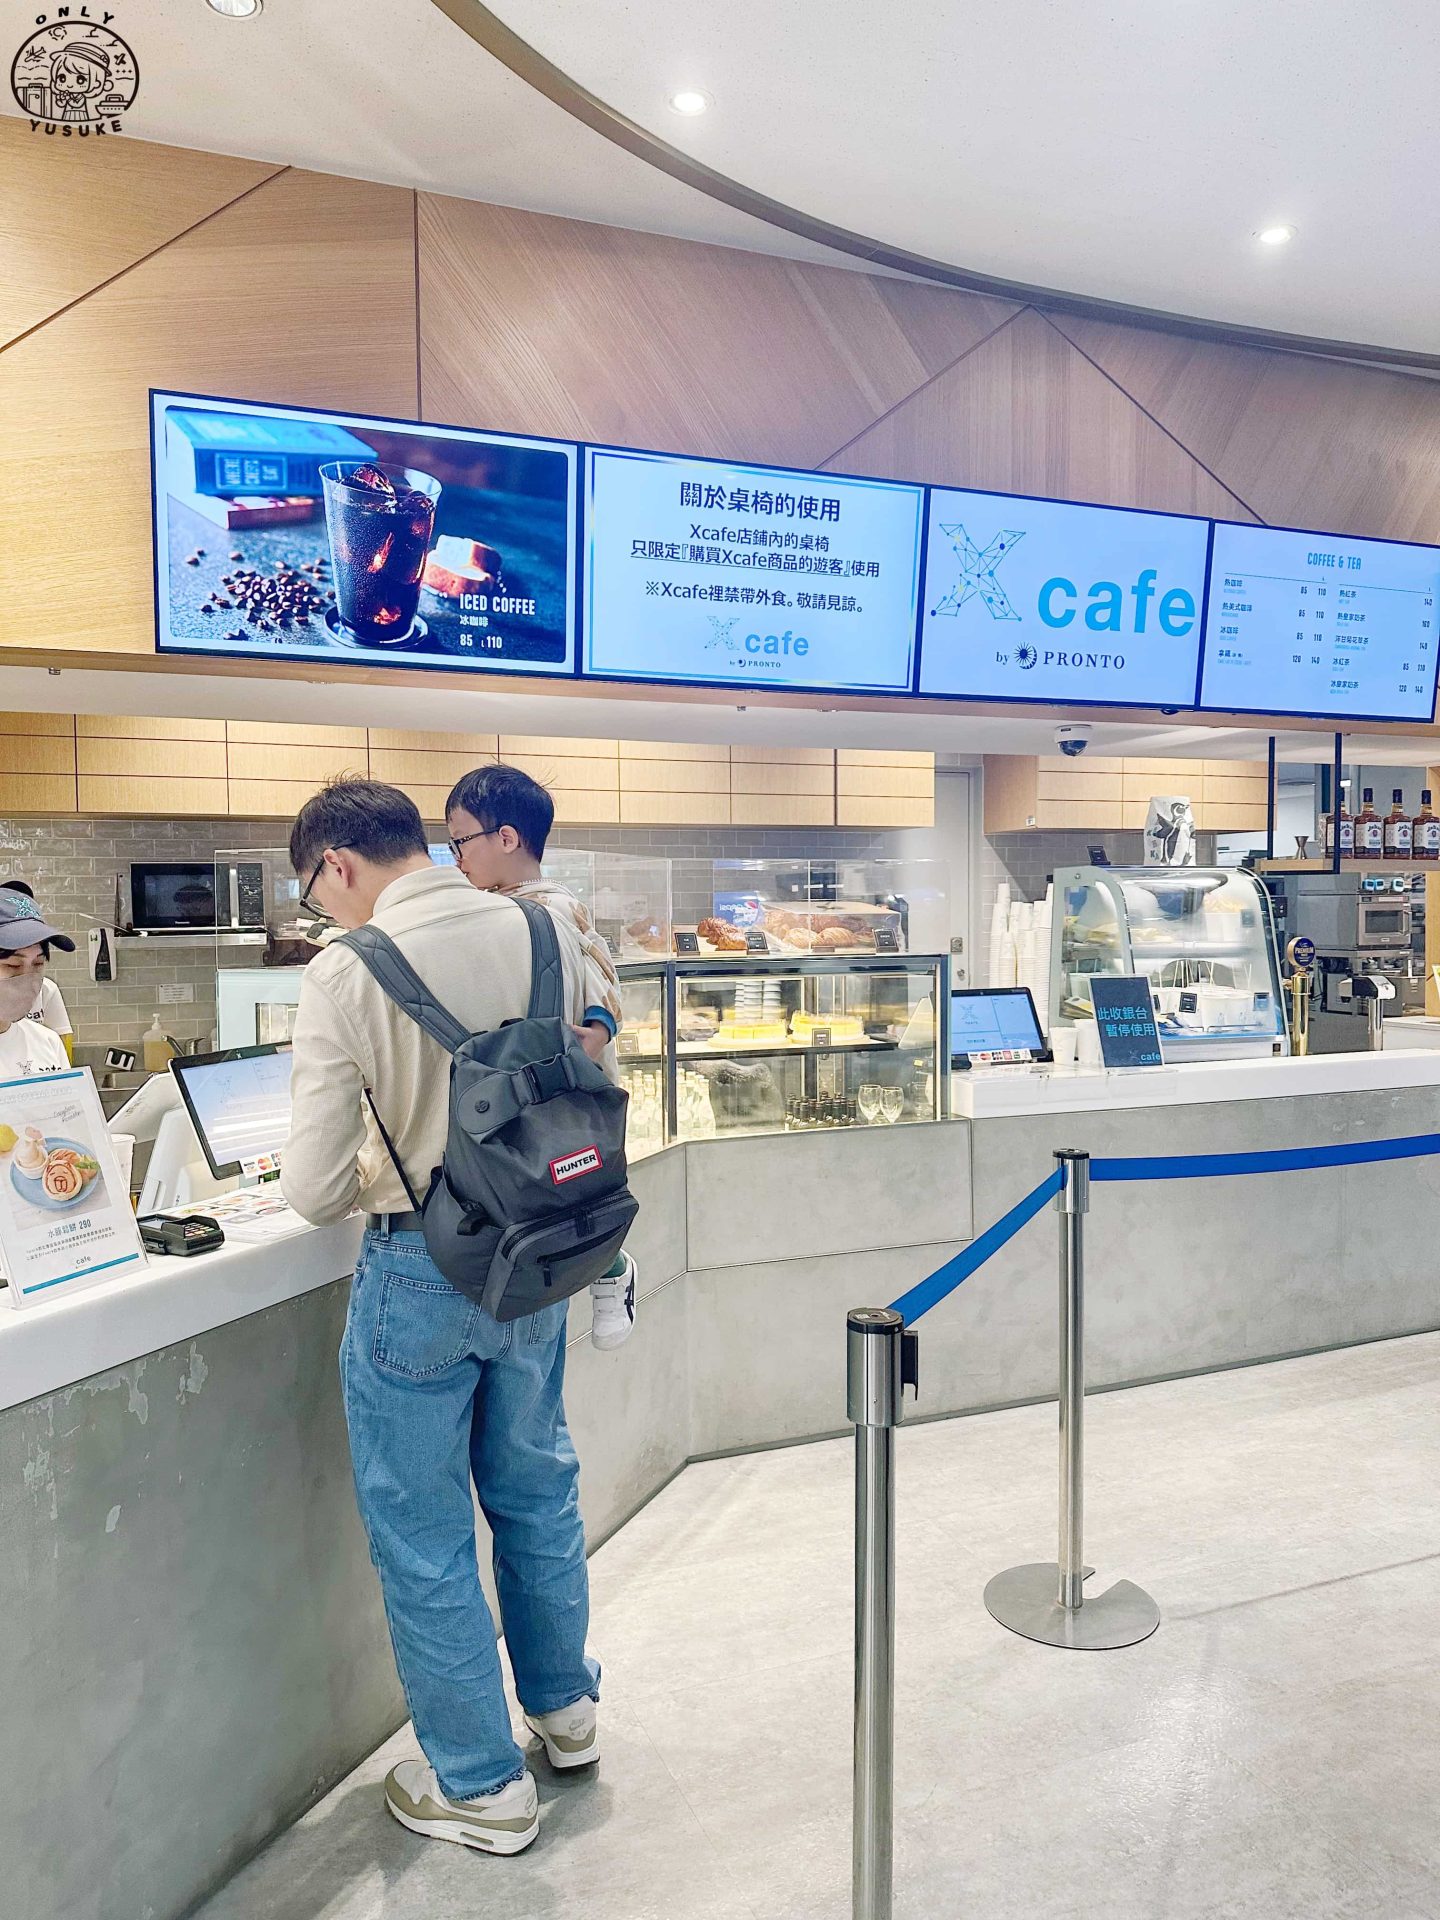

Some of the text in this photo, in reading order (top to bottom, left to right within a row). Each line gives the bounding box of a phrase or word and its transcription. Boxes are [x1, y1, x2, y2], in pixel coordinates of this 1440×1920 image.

[680, 482, 841, 522] 關於桌椅的使用
[1308, 552, 1336, 568] COFFEE
[1348, 556, 1362, 570] TEA
[1300, 586, 1308, 594] 85
[1318, 588, 1326, 596] 110
[460, 594, 536, 616] ICED COFFEE
[1038, 569, 1196, 636] cafe
[460, 615, 488, 628] 冰咖啡
[460, 634, 473, 646] 85
[486, 636, 502, 648] 110
[745, 630, 809, 656] cafe
[748, 660, 782, 668] PRONTO
[996, 651, 1126, 670] by PRONTO
[1098, 1006, 1148, 1020] 此收銀台
[1106, 1023, 1156, 1037] 暫停使用
[1141, 1052, 1160, 1061] cafe
[556, 1154, 596, 1175] HUNTER
[76, 1256, 91, 1264] cafe
